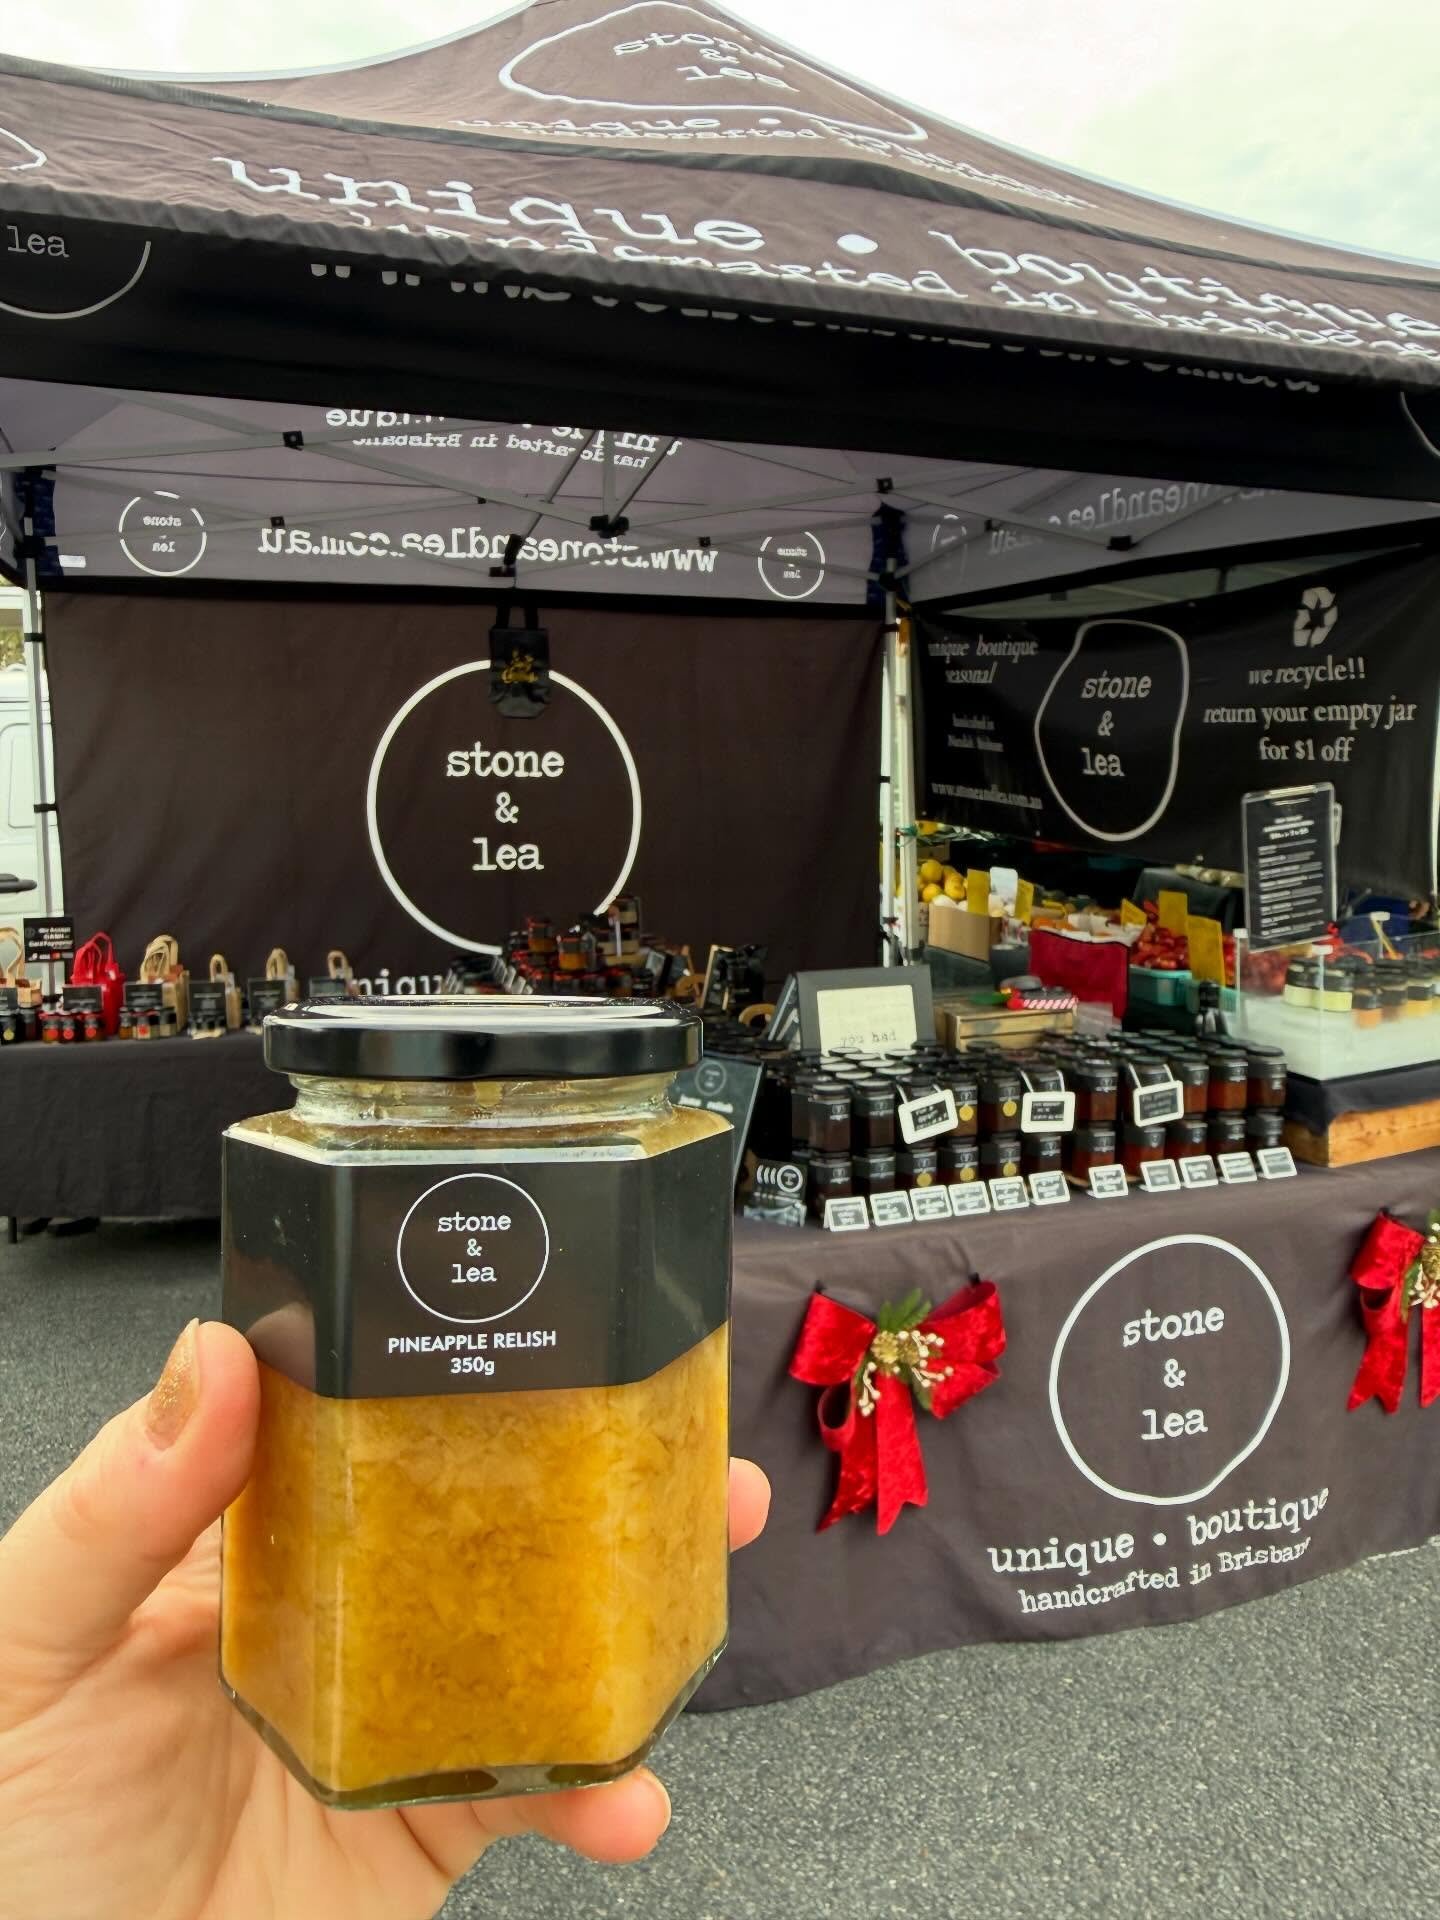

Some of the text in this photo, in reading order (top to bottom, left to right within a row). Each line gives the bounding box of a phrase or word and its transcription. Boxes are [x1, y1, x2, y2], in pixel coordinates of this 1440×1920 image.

[211, 157, 764, 252] unique
[7, 224, 70, 260] lea
[1081, 670, 1152, 699] stone
[1275, 654, 1367, 690] recycle!!
[1098, 710, 1114, 737] &
[1203, 695, 1418, 731] return your empty jar
[446, 741, 565, 778] stone
[1081, 747, 1125, 777] lea
[1259, 736, 1355, 762] for $1 off
[495, 791, 519, 824] &
[472, 836, 545, 872] lea
[437, 1211, 512, 1232] stone
[466, 1238, 483, 1257] &
[451, 1263, 497, 1284] lea
[388, 1330, 557, 1354] PINEAPPLE RELISH
[1122, 1305, 1226, 1348] stone
[450, 1356, 495, 1376] 350g
[1163, 1358, 1187, 1389] &
[1140, 1408, 1209, 1441] lea
[986, 1532, 1135, 1577] unique
[1017, 1566, 1180, 1614] handcrafted
[1188, 1562, 1212, 1586] in
